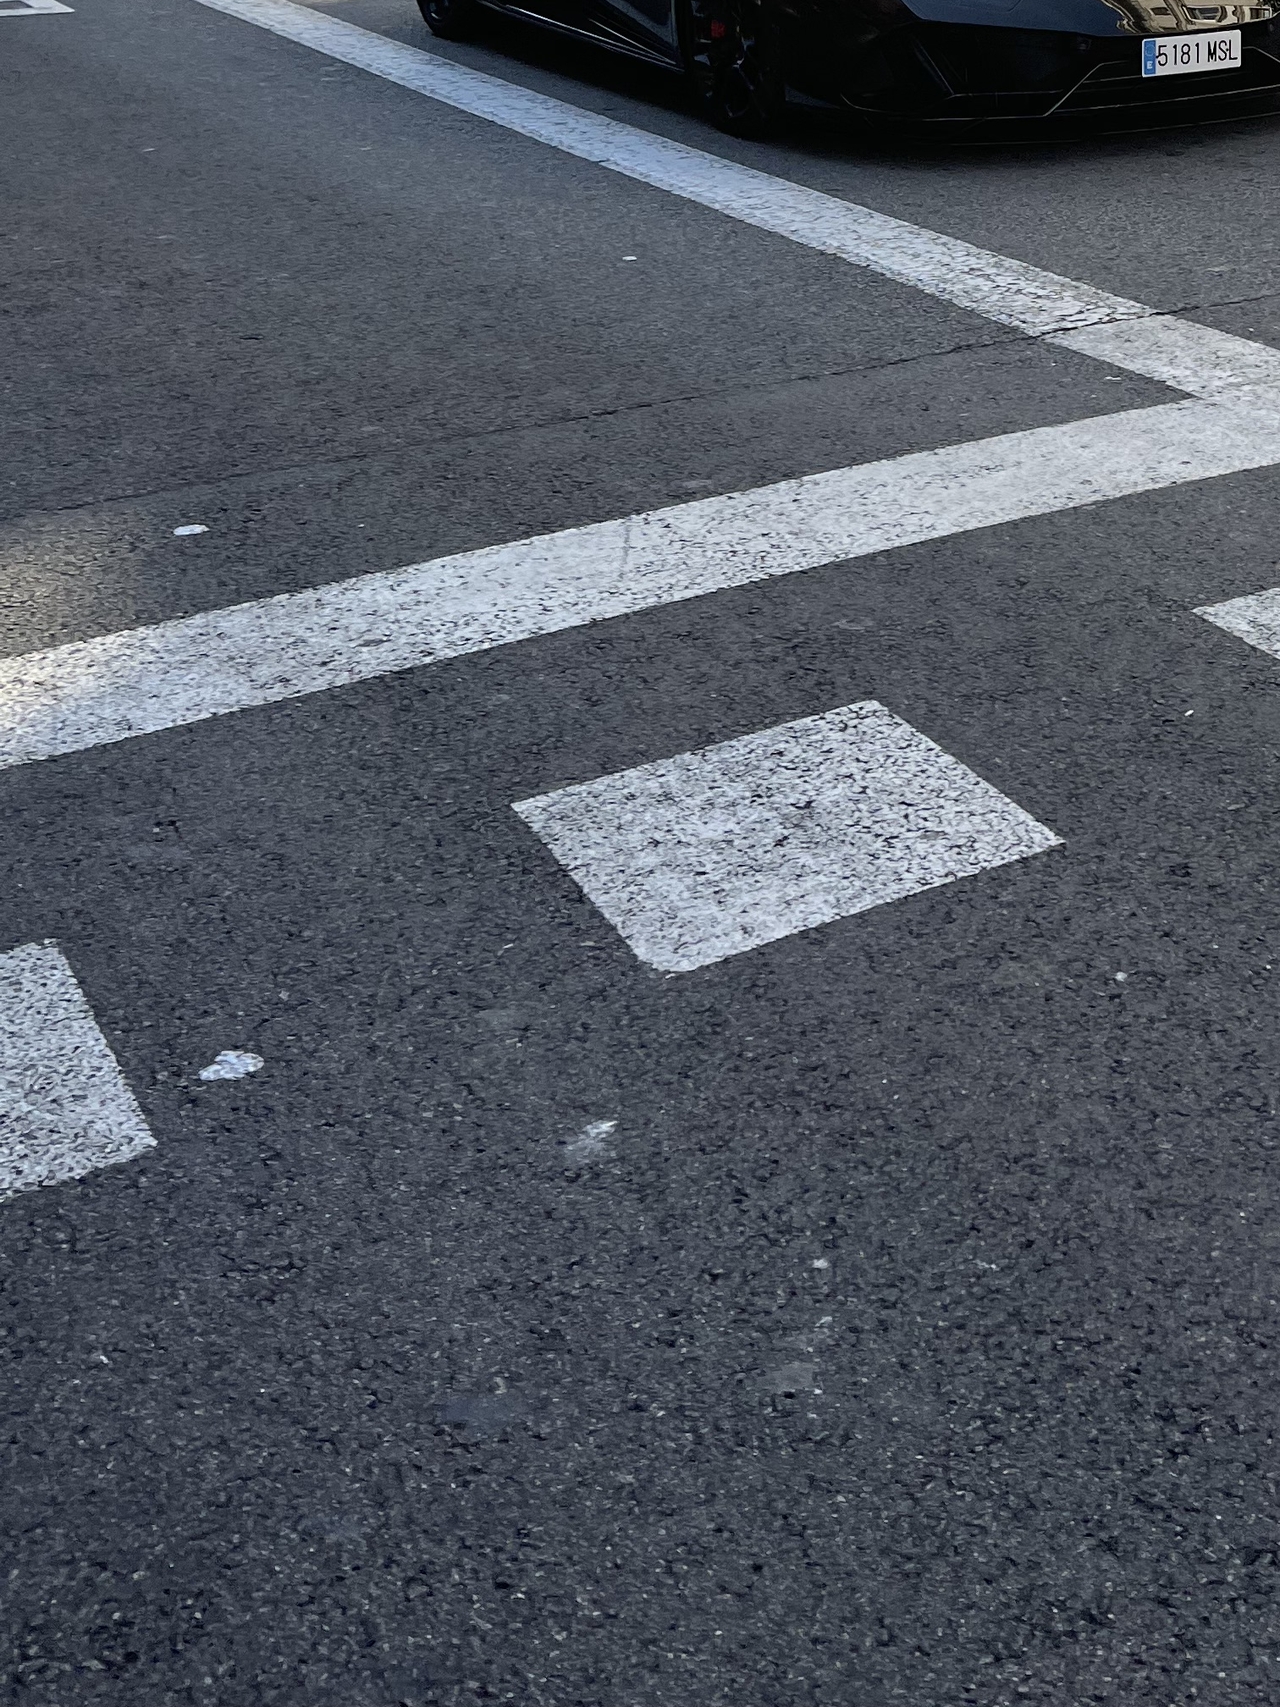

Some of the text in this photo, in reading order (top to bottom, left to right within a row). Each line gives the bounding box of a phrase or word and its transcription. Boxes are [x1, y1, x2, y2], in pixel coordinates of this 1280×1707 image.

[1156, 39, 1238, 66] 5181 MSL
[1146, 60, 1153, 69] E
